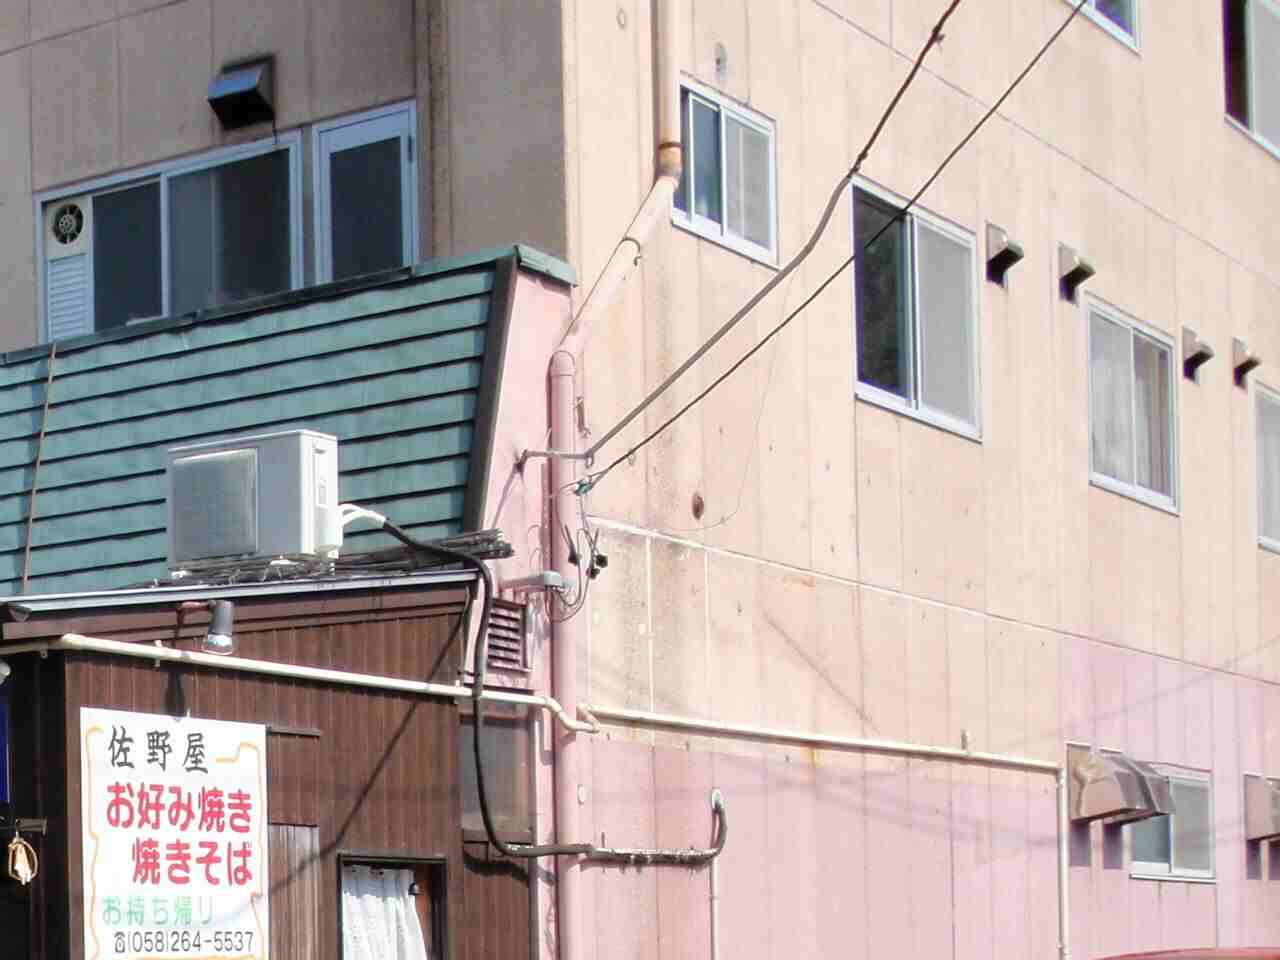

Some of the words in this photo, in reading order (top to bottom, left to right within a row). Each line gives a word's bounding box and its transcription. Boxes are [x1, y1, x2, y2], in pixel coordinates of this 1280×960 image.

[108, 725, 208, 774] 佐野屋
[106, 781, 253, 833] お好み焼き
[132, 837, 253, 886] 焼きそば
[102, 895, 213, 926] お持ち帰り
